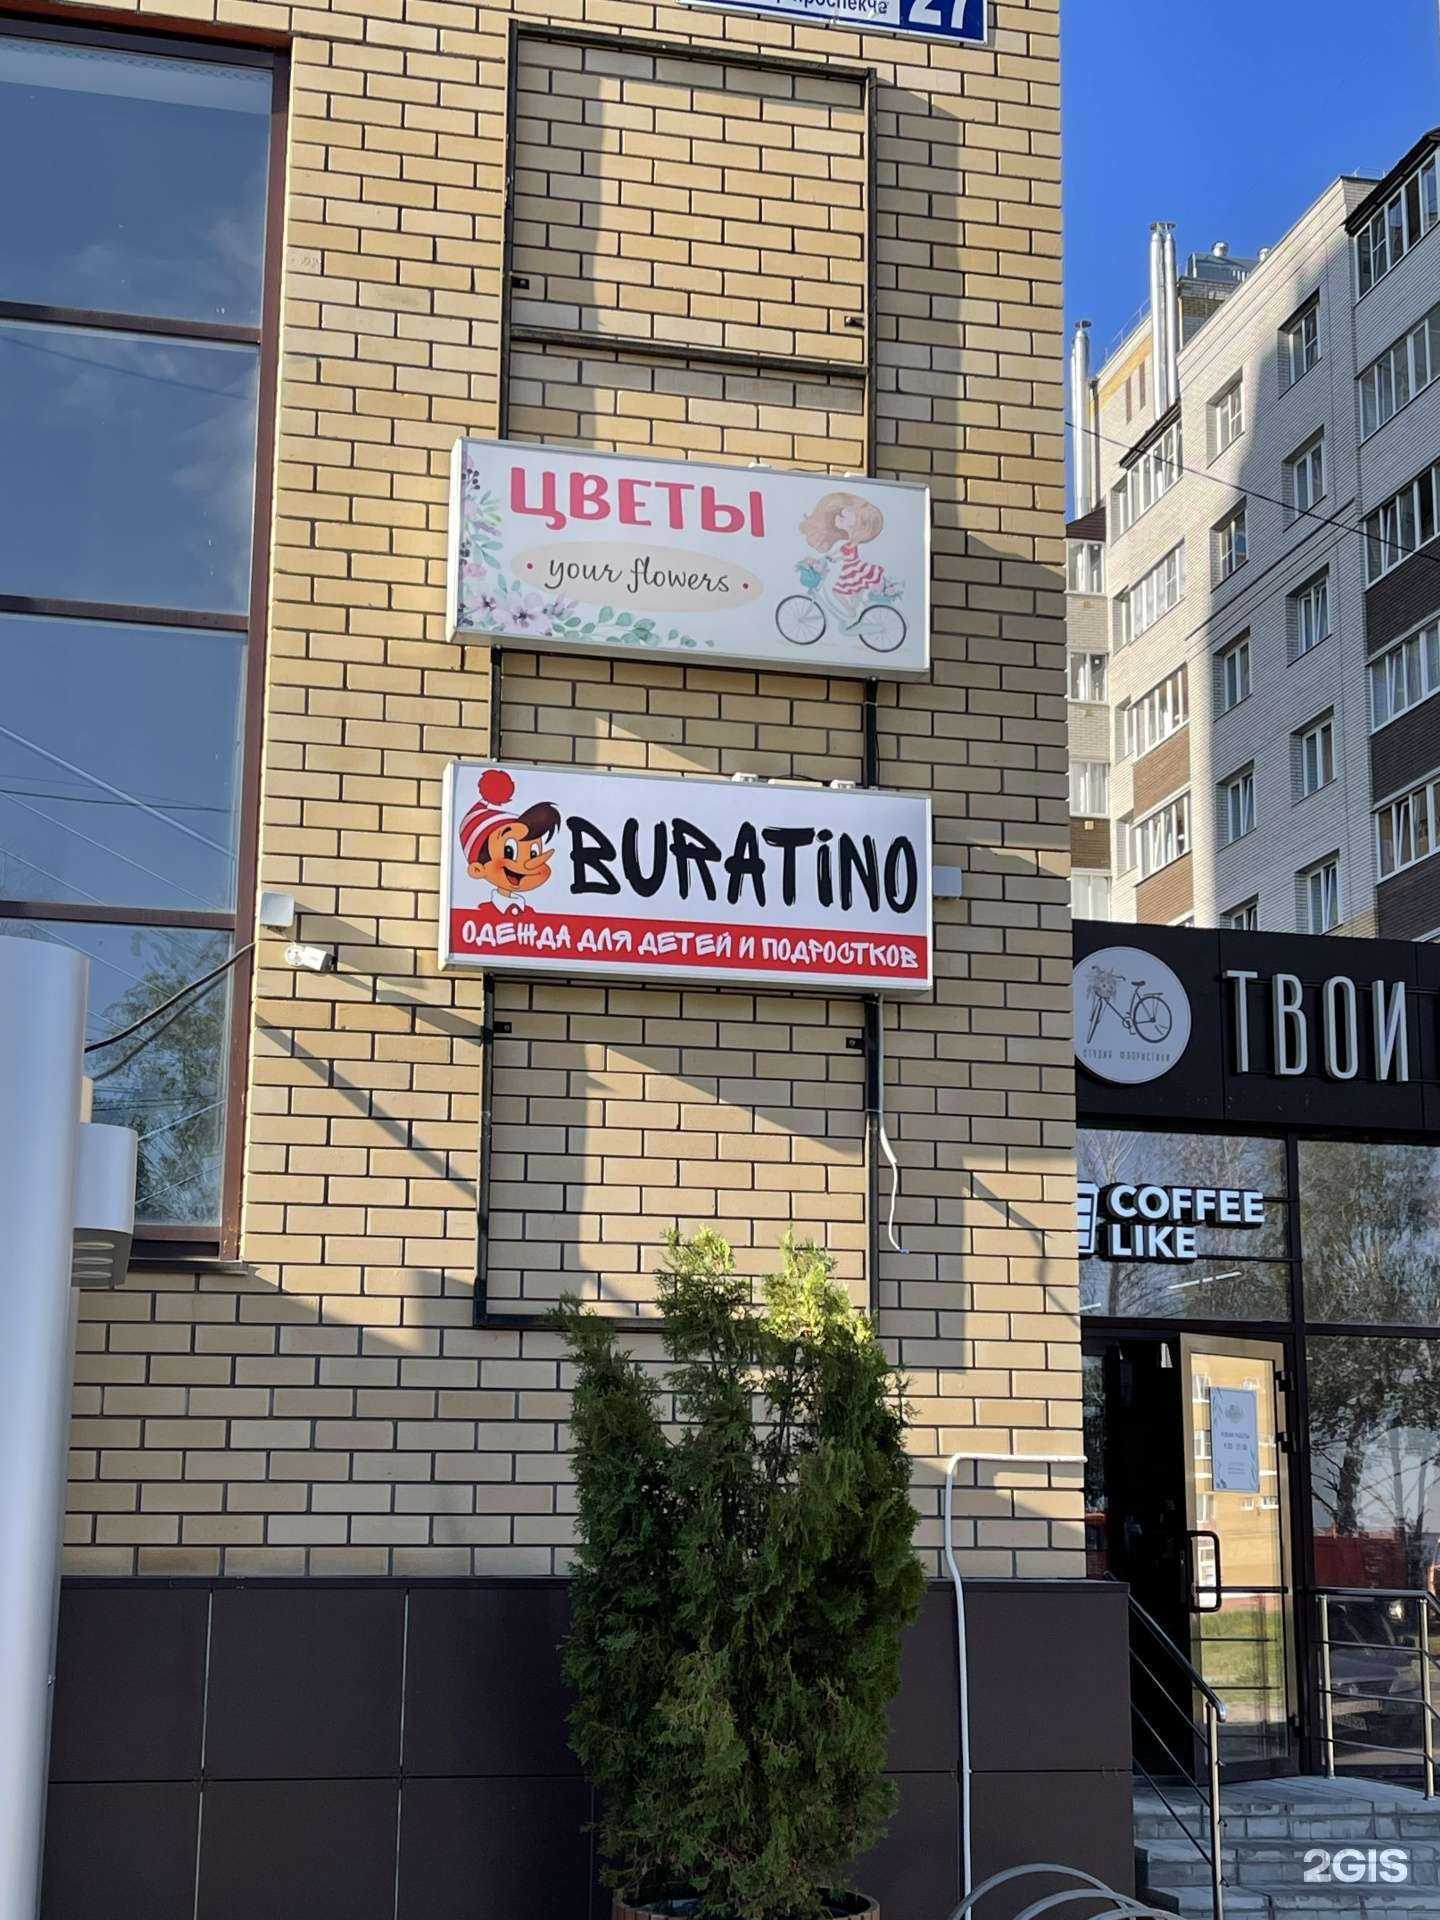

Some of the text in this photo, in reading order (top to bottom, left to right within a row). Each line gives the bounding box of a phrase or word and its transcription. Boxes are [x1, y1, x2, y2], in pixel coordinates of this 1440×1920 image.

[510, 467, 766, 537] ЦВЕТЫ
[544, 556, 730, 594] your flowers
[462, 920, 919, 969] ОДЕЖДА ДЛЯ ДЕТЕЙ И ПОДРОСТКОВ
[1223, 970, 1409, 1083] ТВОИ
[1107, 1183, 1266, 1224] COFFEE
[1109, 1223, 1199, 1259] LIKE
